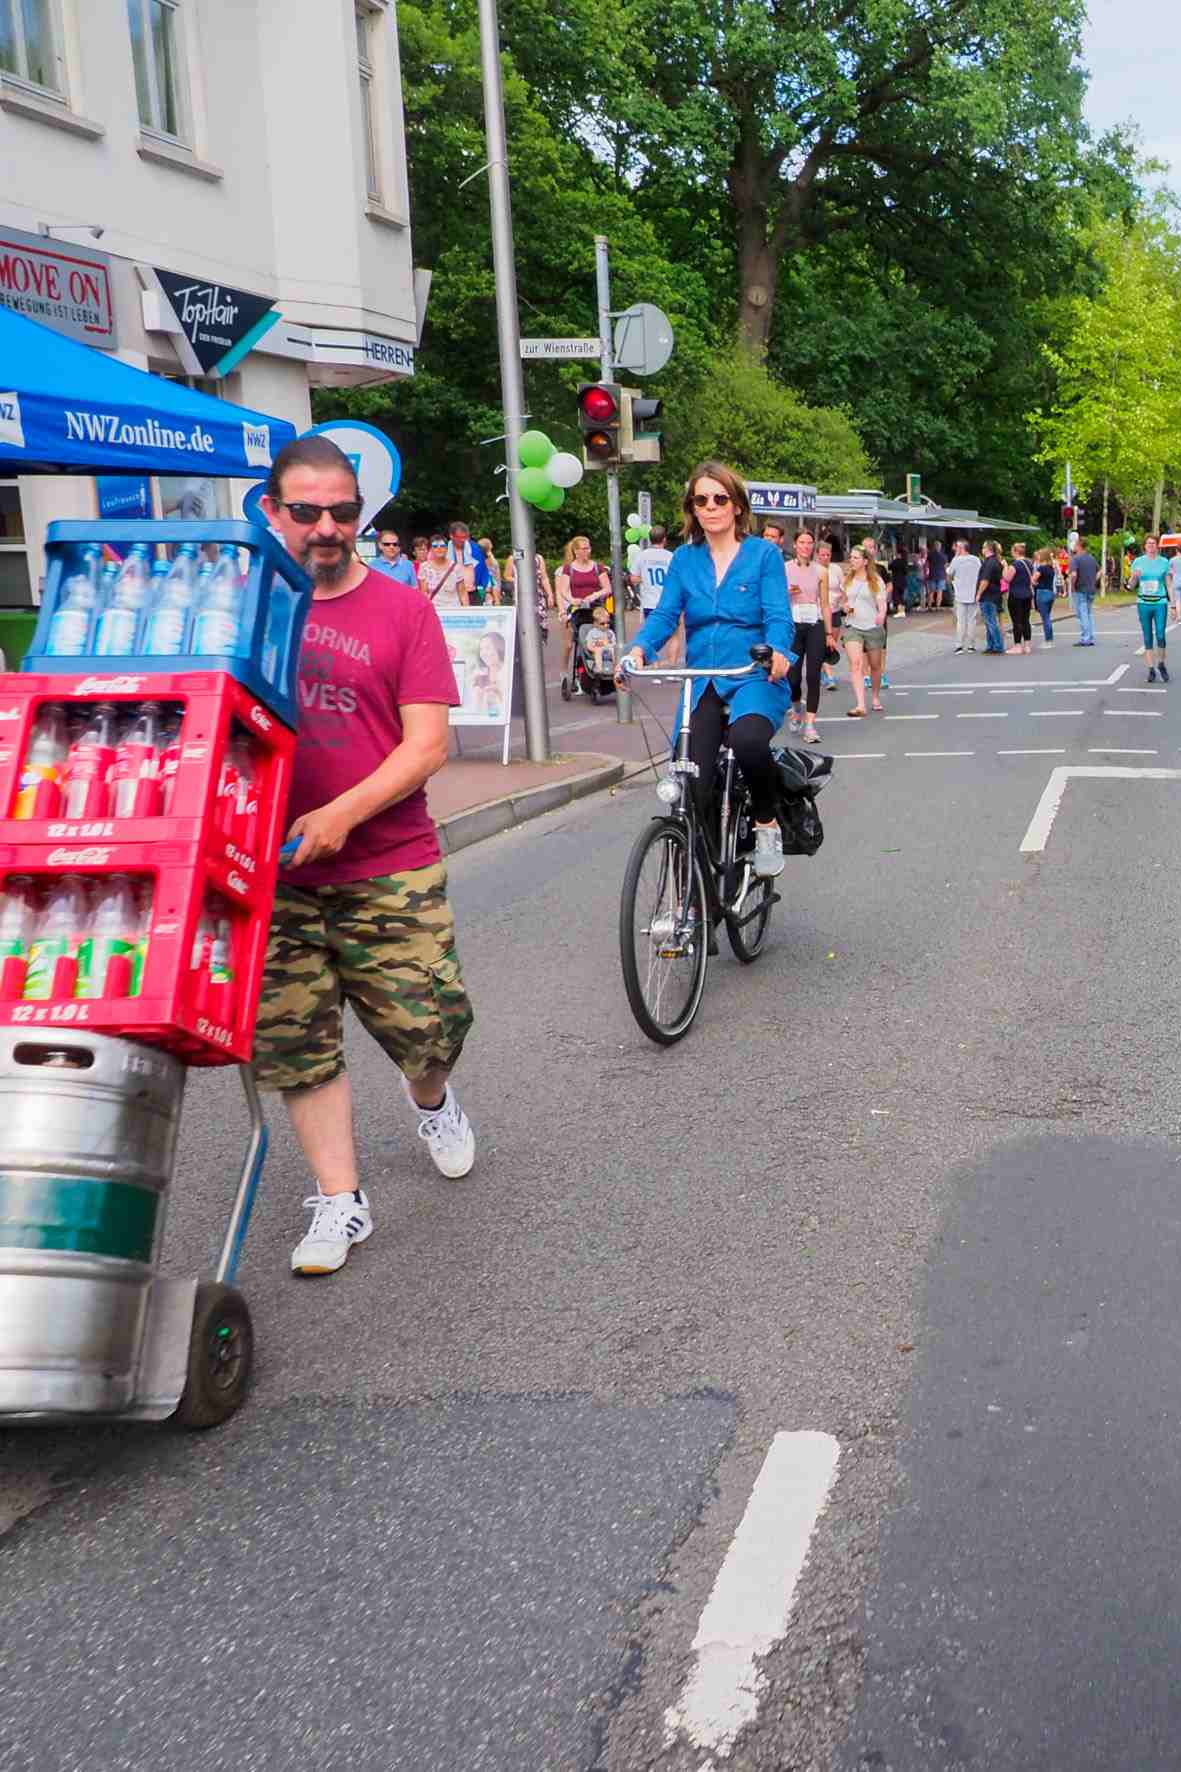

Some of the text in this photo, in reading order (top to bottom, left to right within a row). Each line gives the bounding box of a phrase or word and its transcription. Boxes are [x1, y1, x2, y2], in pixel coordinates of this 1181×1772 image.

[69, 270, 100, 307] ON
[71, 307, 100, 324] LEBEN
[173, 284, 239, 344] TopHair
[524, 342, 595, 354] zur Wienstraße
[64, 410, 215, 454] NWZonline.de
[247, 431, 266, 448] NWZ
[647, 567, 665, 586] 10
[47, 823, 67, 837] 12
[11, 1004, 34, 1022] 12
[32, 1008, 49, 1022] x
[76, 1004, 89, 1020] L
